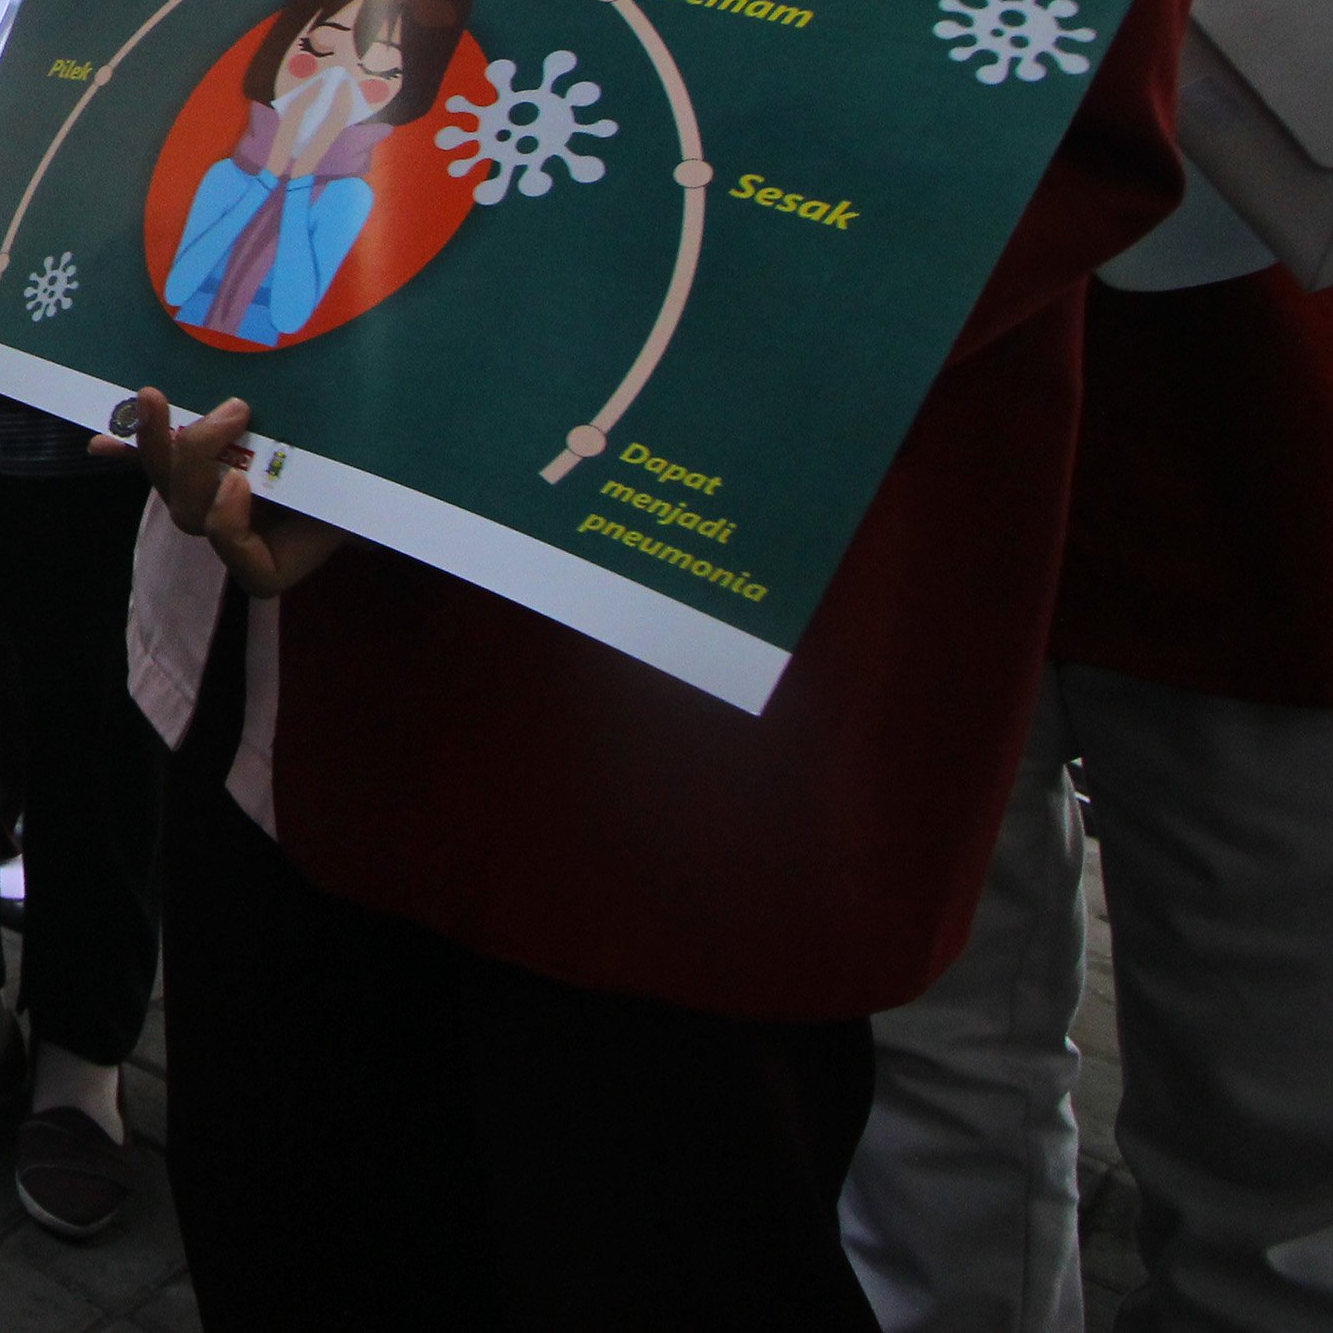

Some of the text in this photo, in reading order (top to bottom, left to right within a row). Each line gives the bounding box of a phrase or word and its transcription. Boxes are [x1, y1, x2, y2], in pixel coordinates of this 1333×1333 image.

[47, 59, 95, 82] Pilek
[729, 173, 861, 230] Sesak
[619, 442, 724, 496] Dapat
[599, 479, 738, 544] menjadi
[576, 513, 769, 603] pneumonia
